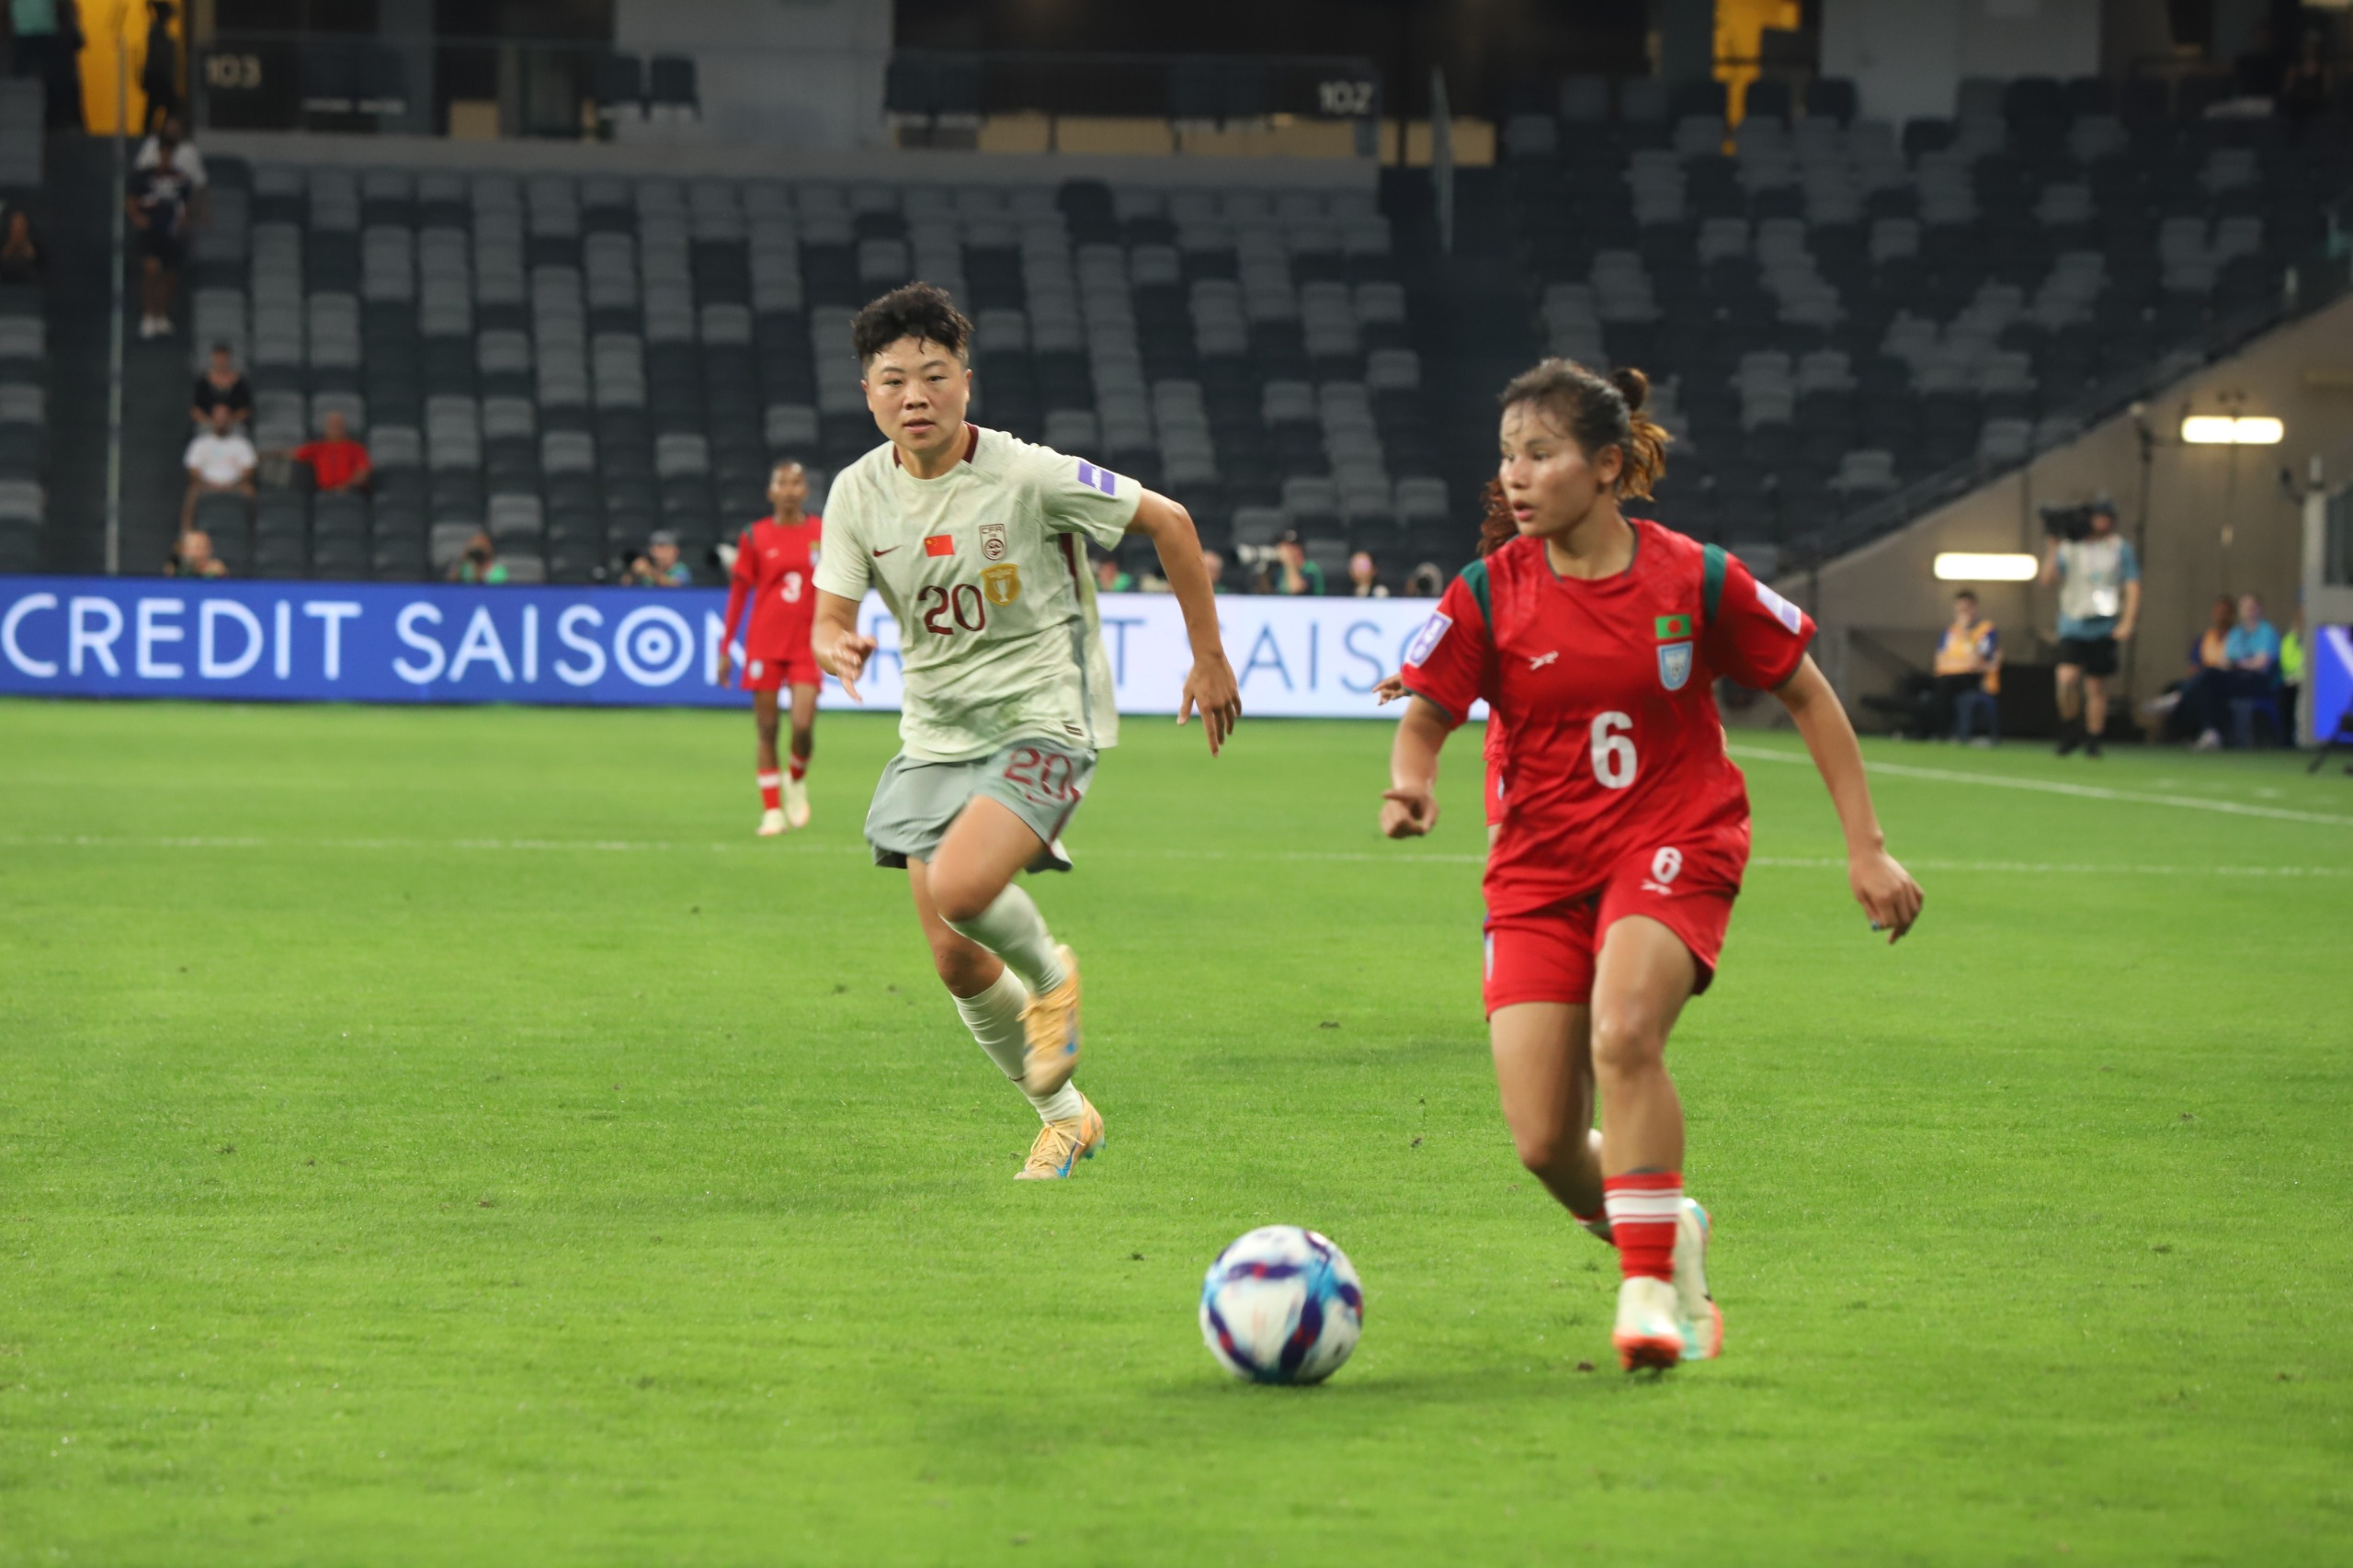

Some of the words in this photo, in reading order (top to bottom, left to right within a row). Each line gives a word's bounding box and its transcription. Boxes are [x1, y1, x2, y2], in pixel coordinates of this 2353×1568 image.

[206, 54, 261, 87] 103
[1320, 81, 1371, 114] 102
[782, 572, 802, 603] 3
[917, 584, 985, 635] 20
[2, 593, 363, 681] CREDIT
[1590, 710, 1638, 790] 6
[1004, 746, 1073, 801] 20
[1651, 846, 1683, 885] 6
